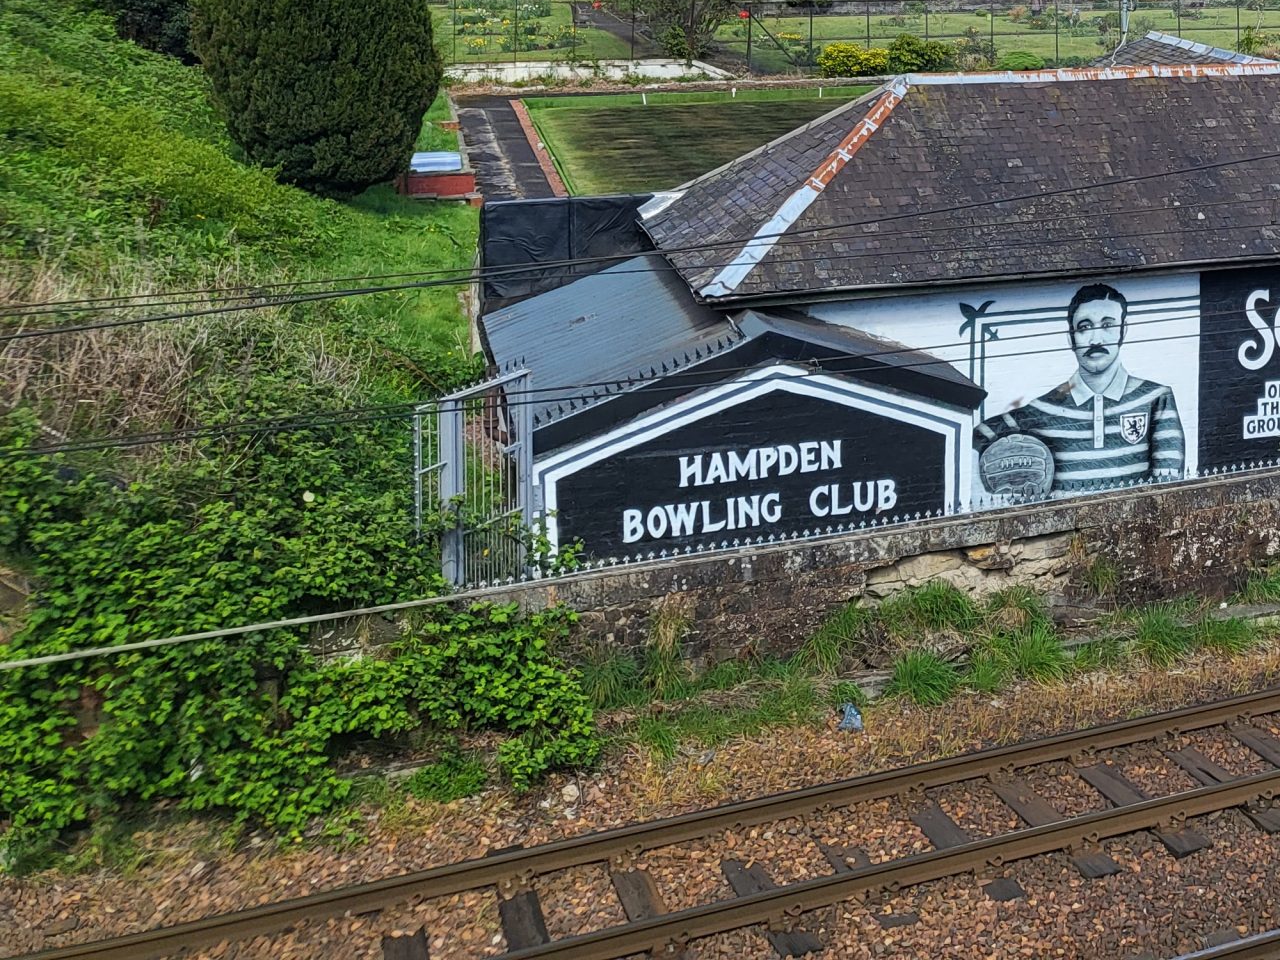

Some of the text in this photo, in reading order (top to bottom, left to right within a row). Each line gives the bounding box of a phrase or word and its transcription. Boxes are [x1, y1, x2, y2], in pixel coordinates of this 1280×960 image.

[678, 439, 843, 488] HAMPDEN
[622, 478, 898, 543] BOWLING CLUB
